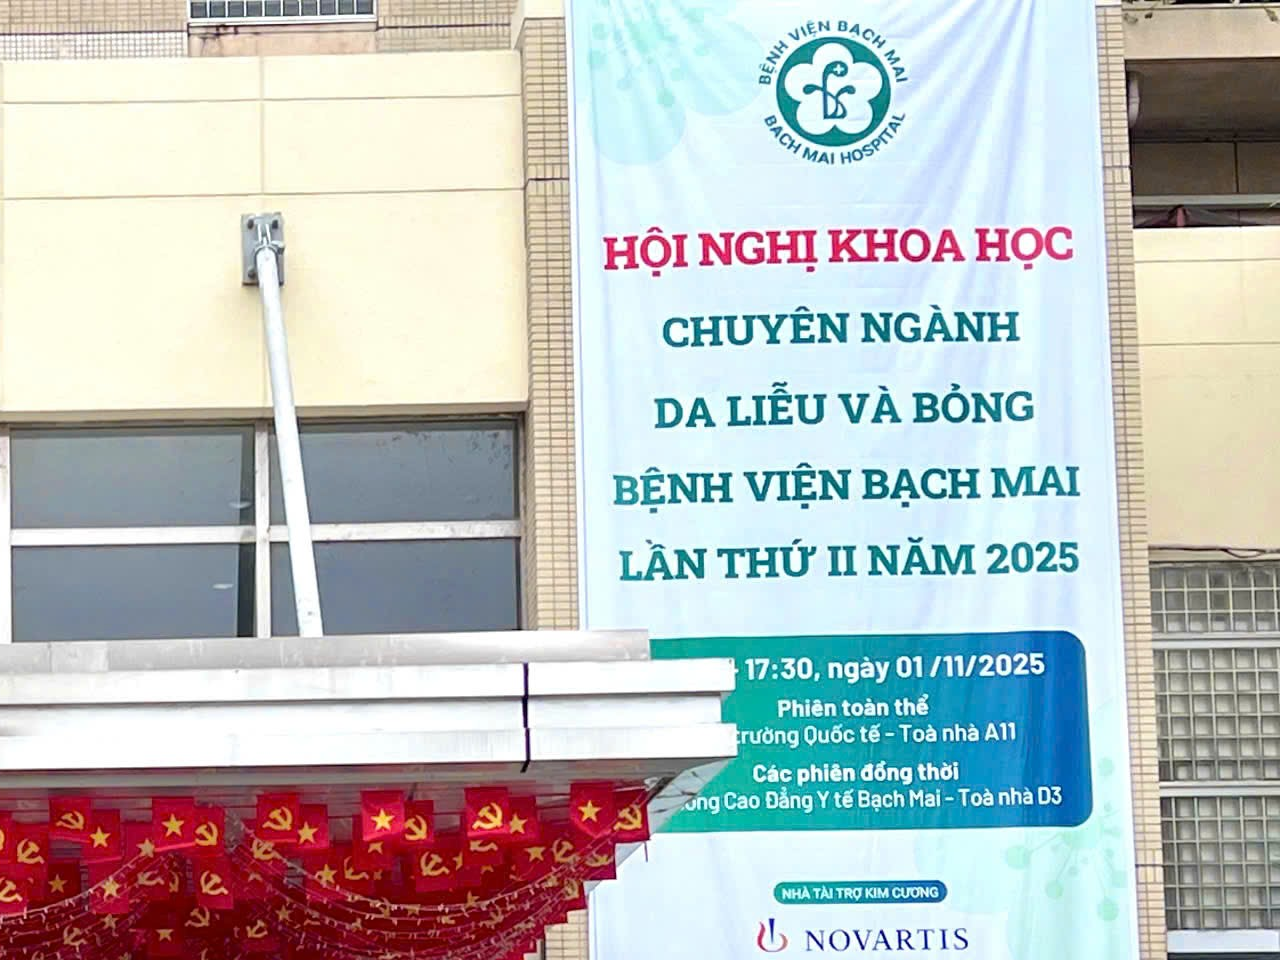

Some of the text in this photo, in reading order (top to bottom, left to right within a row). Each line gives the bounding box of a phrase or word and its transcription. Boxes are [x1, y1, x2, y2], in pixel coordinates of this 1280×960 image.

[884, 49, 908, 83] MAI
[764, 113, 906, 165] BACH MAI HOSPITAL
[603, 226, 1074, 277] HỘI NGHỊ KHOA HỌC
[662, 305, 1020, 348] CHUYÊN NGÀNH
[654, 382, 1035, 429] DA LIỄU VÀ BỎNG
[613, 462, 1080, 514] BỆNH VIỆN BẠCH MAI
[619, 537, 1080, 582] LẦN THỨ II NĂM 2025
[744, 653, 1045, 685] 17:30, ngày 01 /11/2025
[777, 693, 929, 719] Phiên toàn thể
[803, 724, 854, 748] Quốc
[860, 724, 880, 744] tế
[900, 723, 937, 743] Toà
[941, 723, 980, 743] nhà
[985, 721, 1016, 741] A11
[752, 759, 959, 787] Các phiên đồng thời
[723, 791, 760, 810] Cao
[765, 785, 813, 813] Đẳng
[817, 790, 830, 809] Y
[833, 788, 854, 808] tế
[859, 788, 904, 812] Bạch
[908, 788, 941, 807] Mai
[960, 787, 994, 807] Toà
[998, 786, 1032, 806] nhà
[1037, 785, 1062, 805] D3
[781, 885, 939, 903] NHÀ TÀI TRỢ KIM CƯƠNG
[805, 927, 969, 952] NOVARTIS
